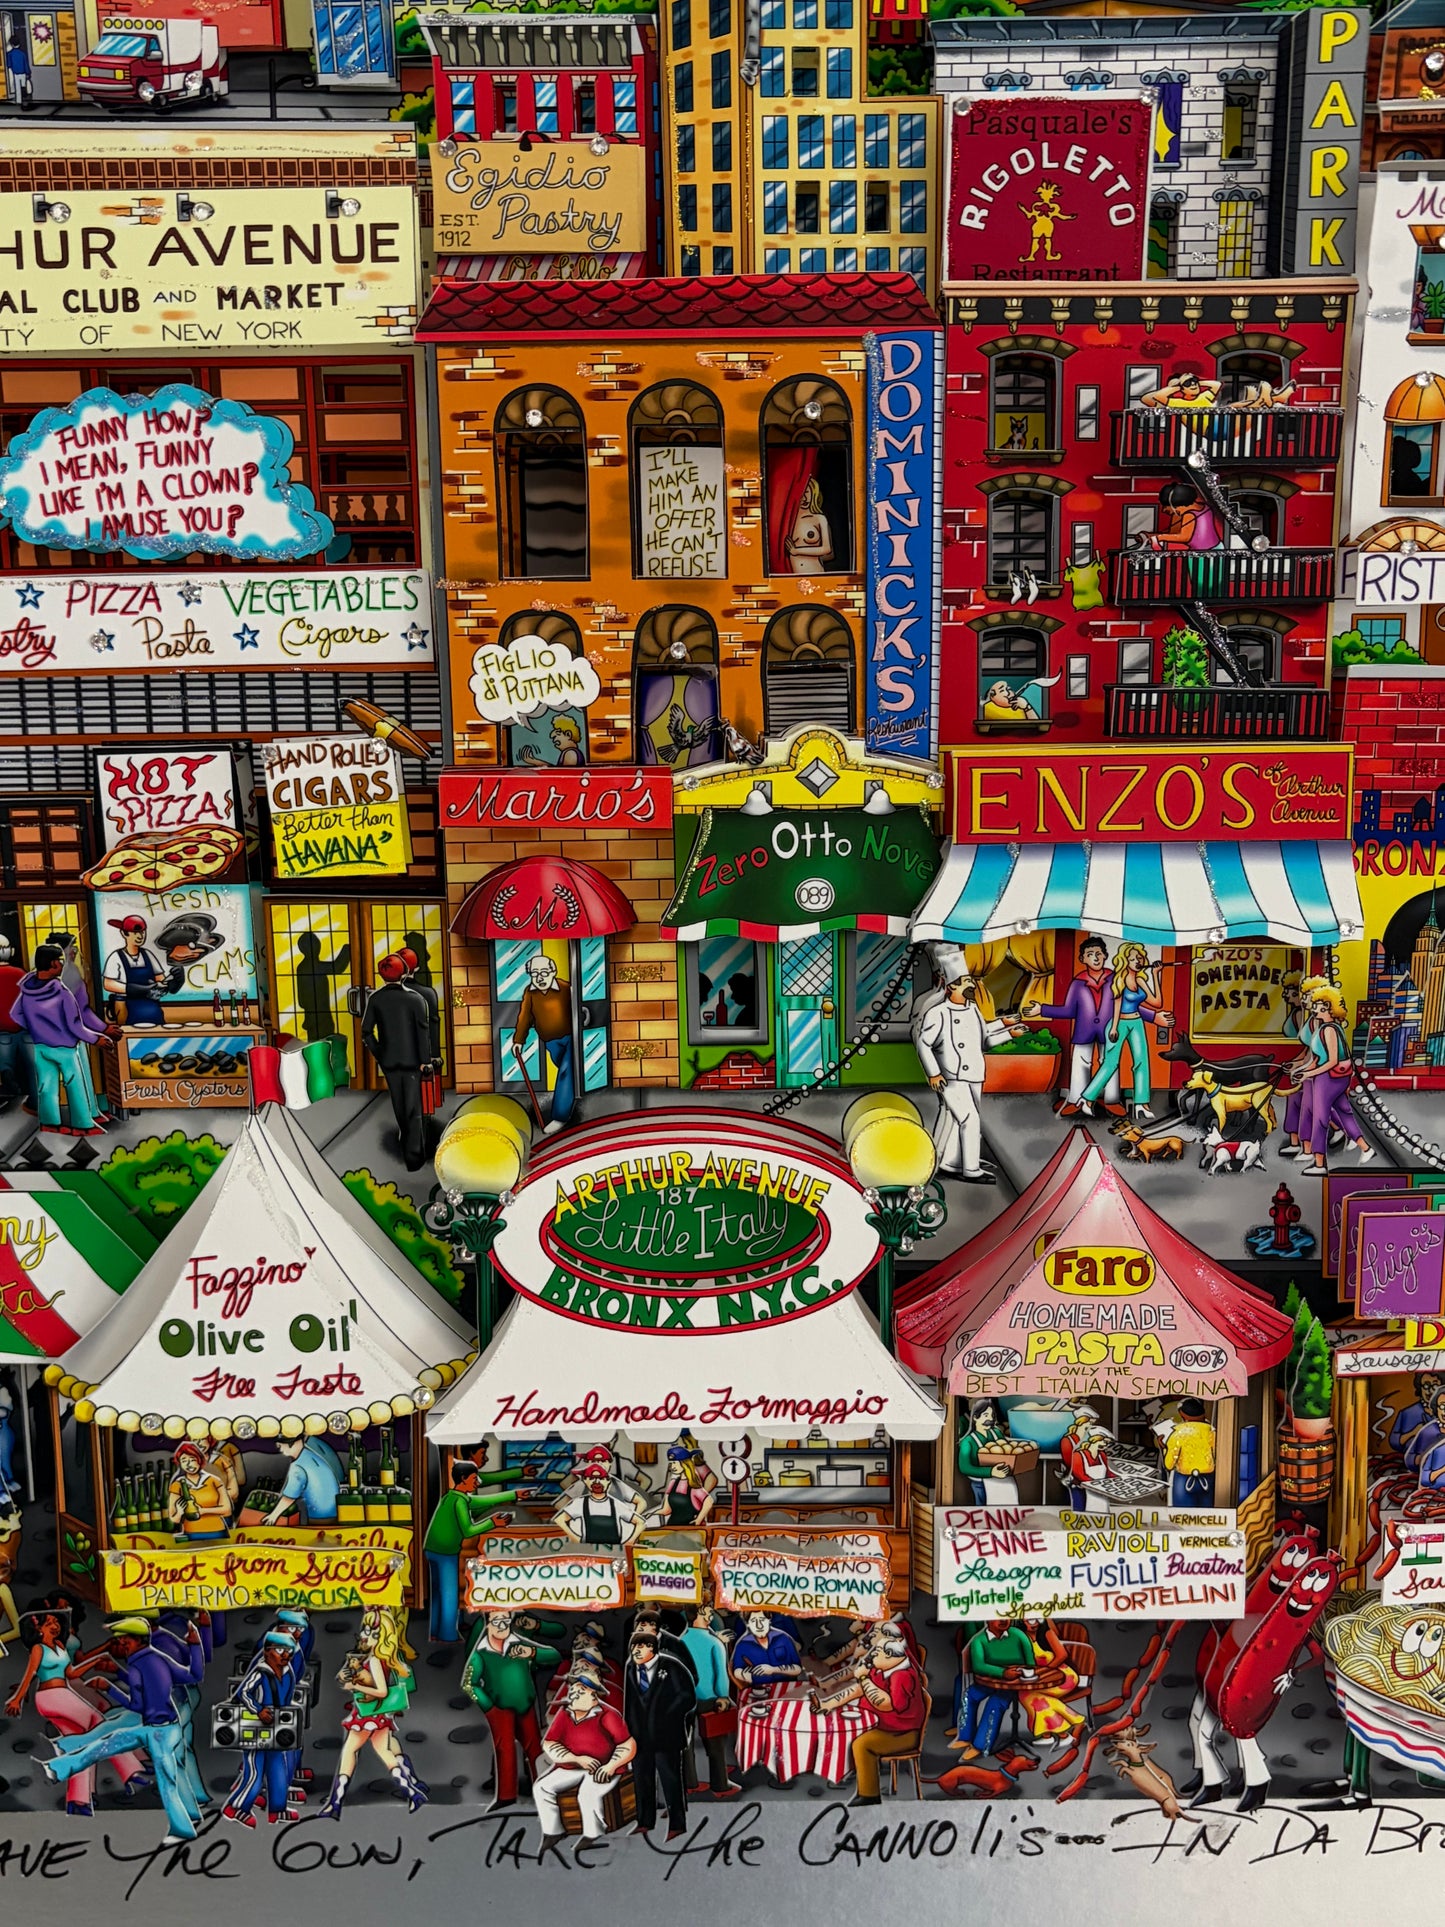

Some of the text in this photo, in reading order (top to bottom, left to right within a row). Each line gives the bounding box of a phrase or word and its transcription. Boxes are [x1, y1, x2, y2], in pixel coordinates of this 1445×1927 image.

[966, 109, 1132, 141] Pasquale's
[1309, 11, 1359, 266] PARK
[446, 149, 610, 210] Egidio
[960, 142, 1135, 230] RIGOLETTO
[440, 193, 623, 250] EST. Pastry
[147, 222, 400, 267] AVENUE
[438, 231, 471, 247] 1912
[0, 283, 345, 313] AL CLUB AND MARKET
[80, 325, 113, 345] OF
[162, 323, 223, 342] NEW
[236, 321, 303, 340] YORK
[55, 408, 211, 456] FUNNY HOW?
[39, 437, 214, 485] I MEAN, FUNNY
[646, 448, 693, 471] I'LL
[39, 463, 259, 518] LIKE I'M A CLOWN?
[649, 466, 699, 493] MAKE
[649, 484, 717, 515] HIM AN
[85, 504, 244, 541] I AMUSE YOU?
[655, 507, 715, 529] OFFER
[871, 339, 928, 711] DOMINICK'S
[645, 527, 723, 554] HE CAN'T
[648, 552, 717, 576] REFUSE
[65, 576, 419, 618] PIZZA VEGETABLES
[133, 616, 215, 660] Pasta
[279, 617, 390, 658] Cigars
[478, 649, 556, 676] FIGLIO
[484, 671, 584, 705] di PUTTANA
[867, 707, 929, 745] Restaurant
[103, 755, 217, 799] HOT
[266, 743, 390, 780] HAND ROLLED
[1263, 761, 1288, 785] of
[273, 771, 393, 809] CIGARS
[448, 769, 656, 823] Mario's
[969, 757, 1262, 836] ENZO'S
[1276, 773, 1346, 799] Arthur
[118, 791, 223, 833] PIZZA
[346, 806, 395, 831] than
[1271, 799, 1340, 823] Avenue
[698, 821, 935, 898] Zero Otto Nove
[143, 886, 221, 917] Fresh
[800, 886, 829, 904] 089
[508, 899, 557, 931] M
[187, 947, 256, 989] CLAMS
[1201, 990, 1270, 1013] PASTA
[123, 1080, 248, 1107] Fresh Oysters
[554, 1151, 832, 1224] ARTHUR AVENUE
[657, 1187, 700, 1206] 187
[575, 1194, 788, 1260] Little Italy
[1054, 1250, 1150, 1288] Faro
[1362, 1224, 1441, 1304] Luigi's
[540, 1265, 699, 1328] BRONX
[717, 1265, 844, 1326] N.Y.C.
[1009, 1302, 1177, 1330] HOMEMADE
[159, 1313, 351, 1358] Olive Oil
[1024, 1330, 1165, 1366] PASTA
[966, 1349, 1224, 1371] 100% 100%
[1059, 1365, 1132, 1376] ONLY THE
[192, 1362, 364, 1402] Free Taste
[967, 1375, 1229, 1396] BEST ITALIAN SEMOLINA
[492, 1386, 888, 1428] Handmade Formaggio
[1169, 1514, 1228, 1526] VERMICELLI
[1067, 1530, 1169, 1559] RAVIOLI
[119, 1551, 395, 1594] Direct from Sicily
[722, 1554, 788, 1570] GRANA
[955, 1558, 1062, 1590] Lasagna
[1164, 1552, 1244, 1577] Bucatini
[141, 1584, 364, 1606] PALERMO SIRACUSA
[471, 1584, 612, 1604] CACIOCAVALLO
[637, 1575, 696, 1590] TALEGGIO
[722, 1570, 886, 1595] PECORINO ROMANO
[734, 1588, 859, 1611] MOZZARELLA
[941, 1583, 1237, 1619] Tagliatelle Spaghetti TORTELLINI
